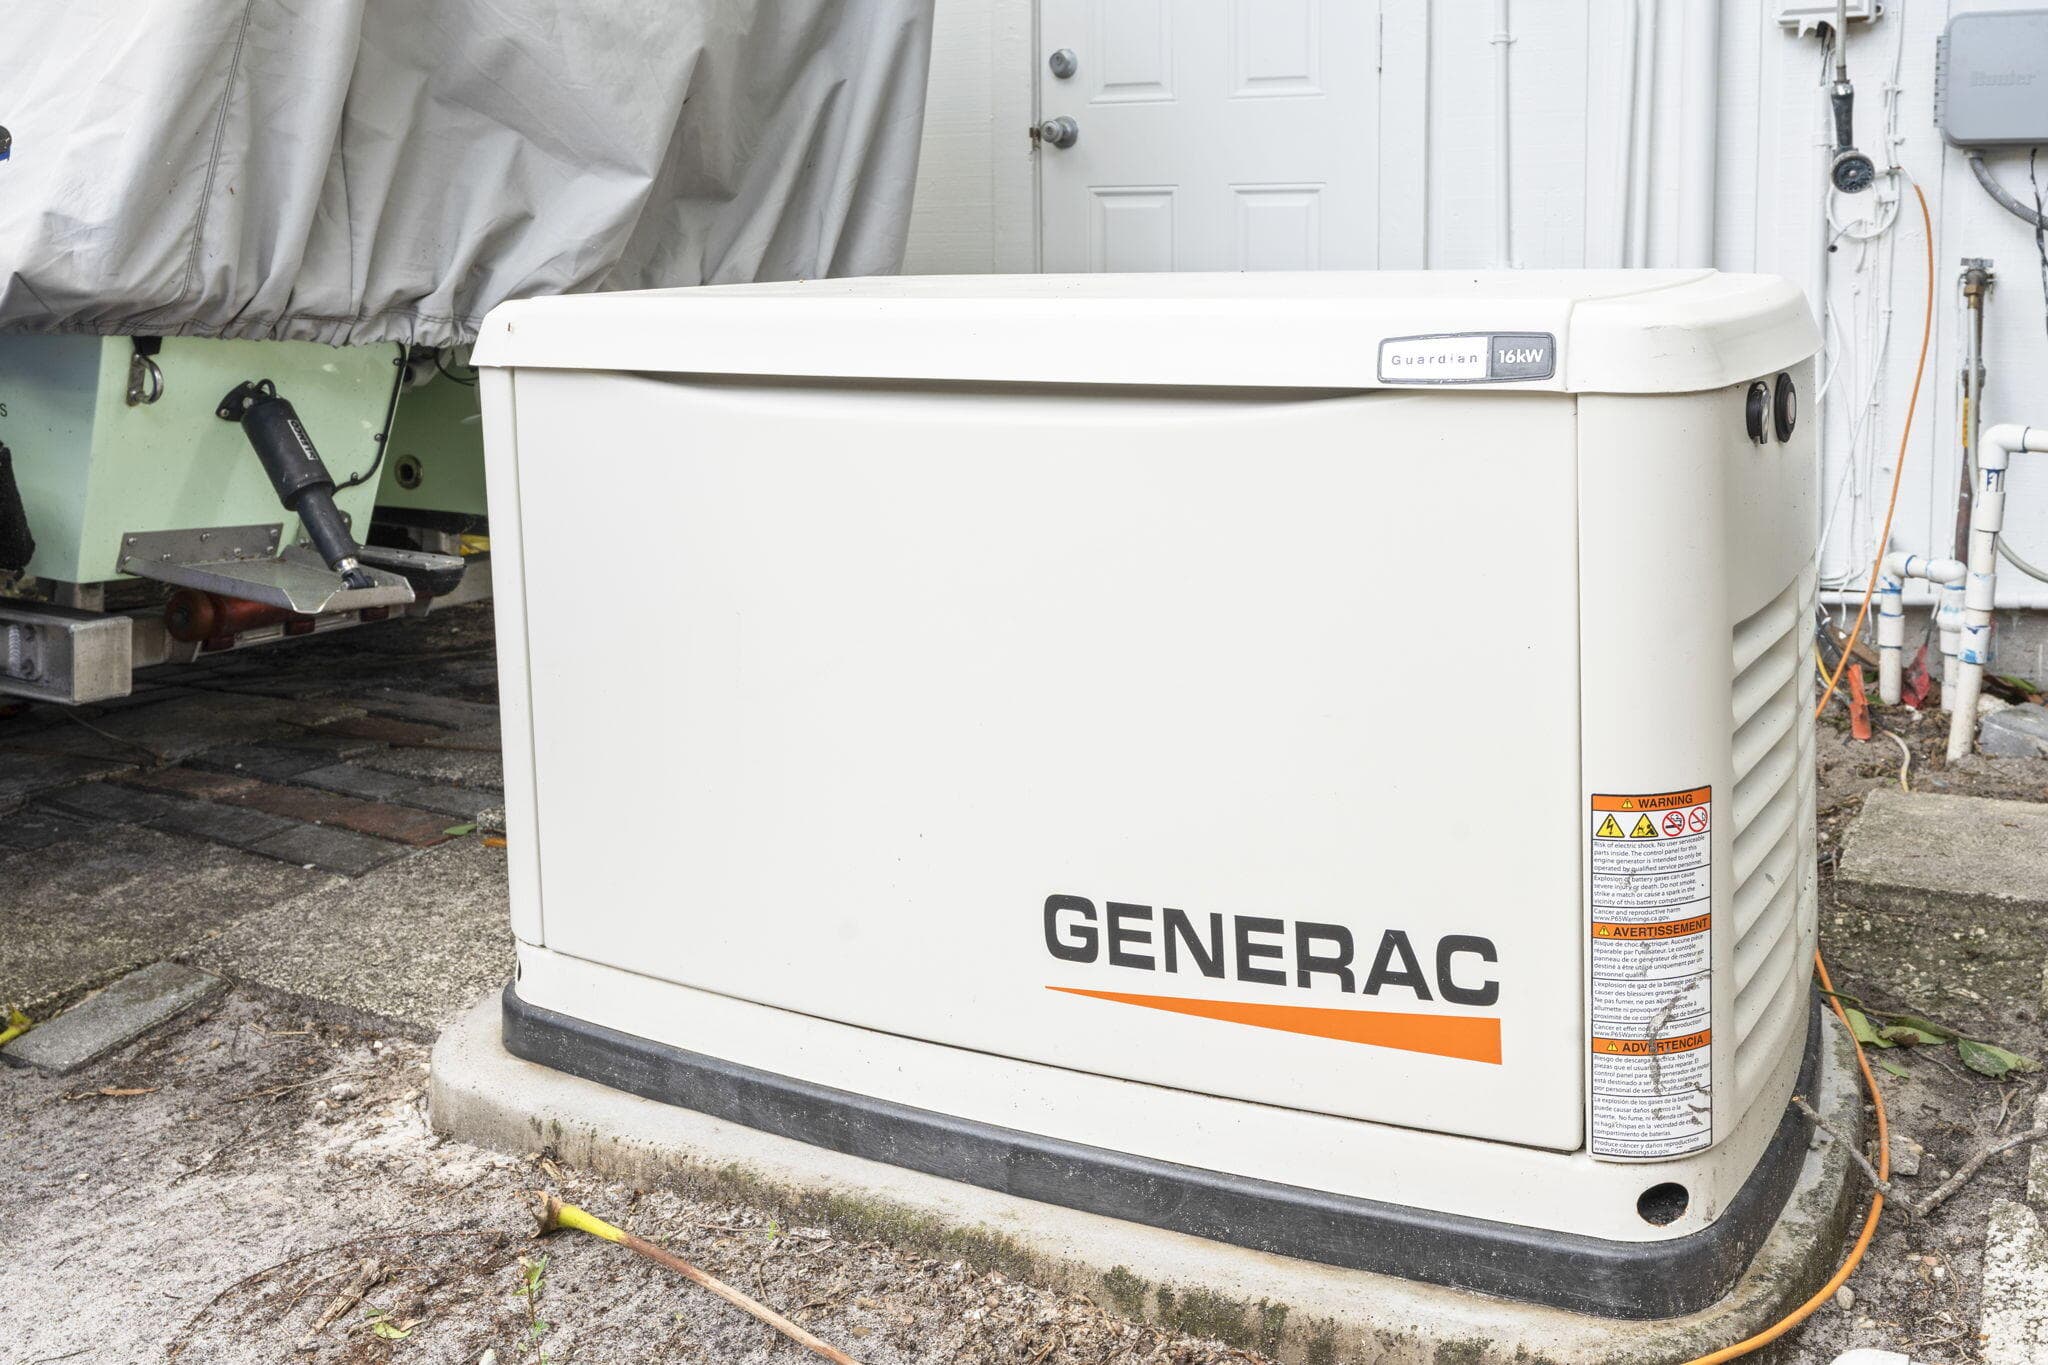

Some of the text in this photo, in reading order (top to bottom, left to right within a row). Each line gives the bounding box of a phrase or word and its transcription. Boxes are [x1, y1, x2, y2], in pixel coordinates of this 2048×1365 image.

[1391, 349, 1543, 366] Guardian 16kW
[1638, 794, 1692, 809] WARNING
[1664, 847, 1679, 856] panel
[1652, 855, 1677, 863] intended
[1594, 875, 1623, 883] Explosion
[1666, 888, 1680, 897] spark
[1594, 898, 1615, 906] vicinity
[1629, 909, 1665, 917] reproductive
[1613, 918, 1708, 936] AVERTISSEMENT
[1594, 940, 1614, 948] Risque
[1671, 937, 1690, 945] Aucune
[1044, 894, 1499, 1006] GENERAC
[1678, 951, 1697, 959] moteur
[1594, 981, 1627, 989] L'explosion
[1594, 1005, 1621, 1013] allumette
[1594, 1023, 1614, 1031] Cancer
[1622, 1036, 1704, 1052] ADVRTENCIA
[1624, 1057, 1650, 1065] descarga
[1615, 1122, 1637, 1130] chispas
[1653, 1120, 1678, 1128] vecindad
[1594, 1139, 1619, 1147] Produce
